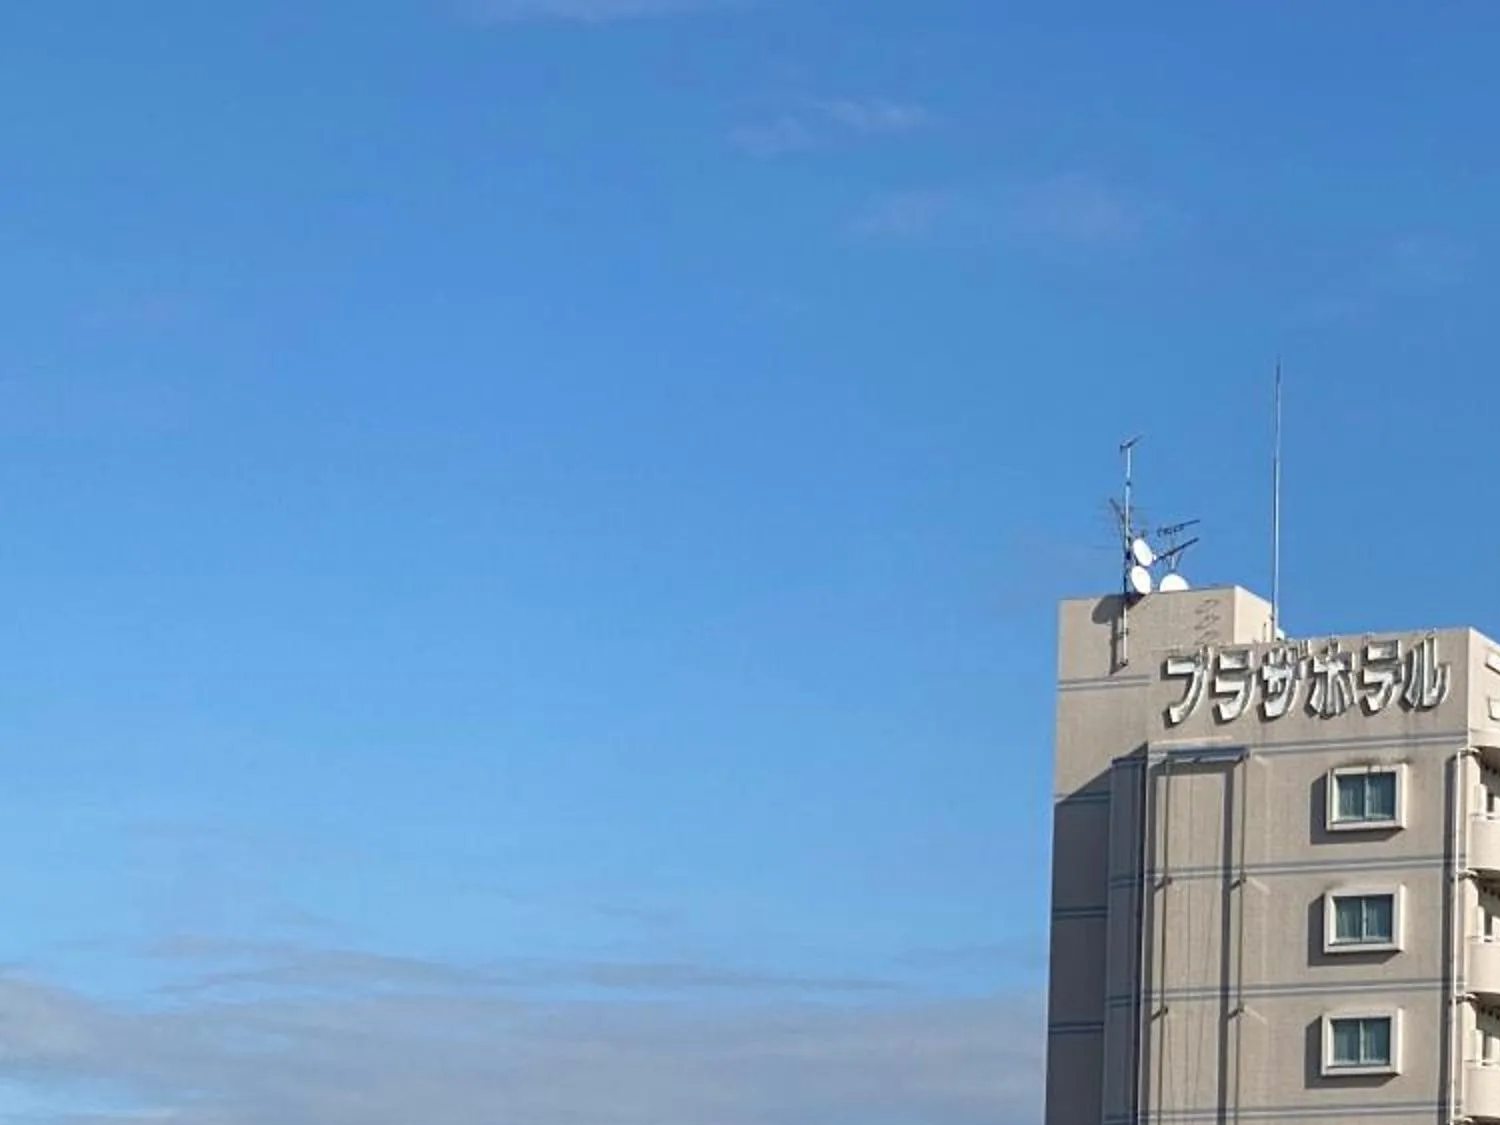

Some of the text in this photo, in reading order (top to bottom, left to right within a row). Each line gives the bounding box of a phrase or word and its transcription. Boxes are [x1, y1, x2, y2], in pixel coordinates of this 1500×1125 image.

[1165, 637, 1451, 724] プラザホテル
